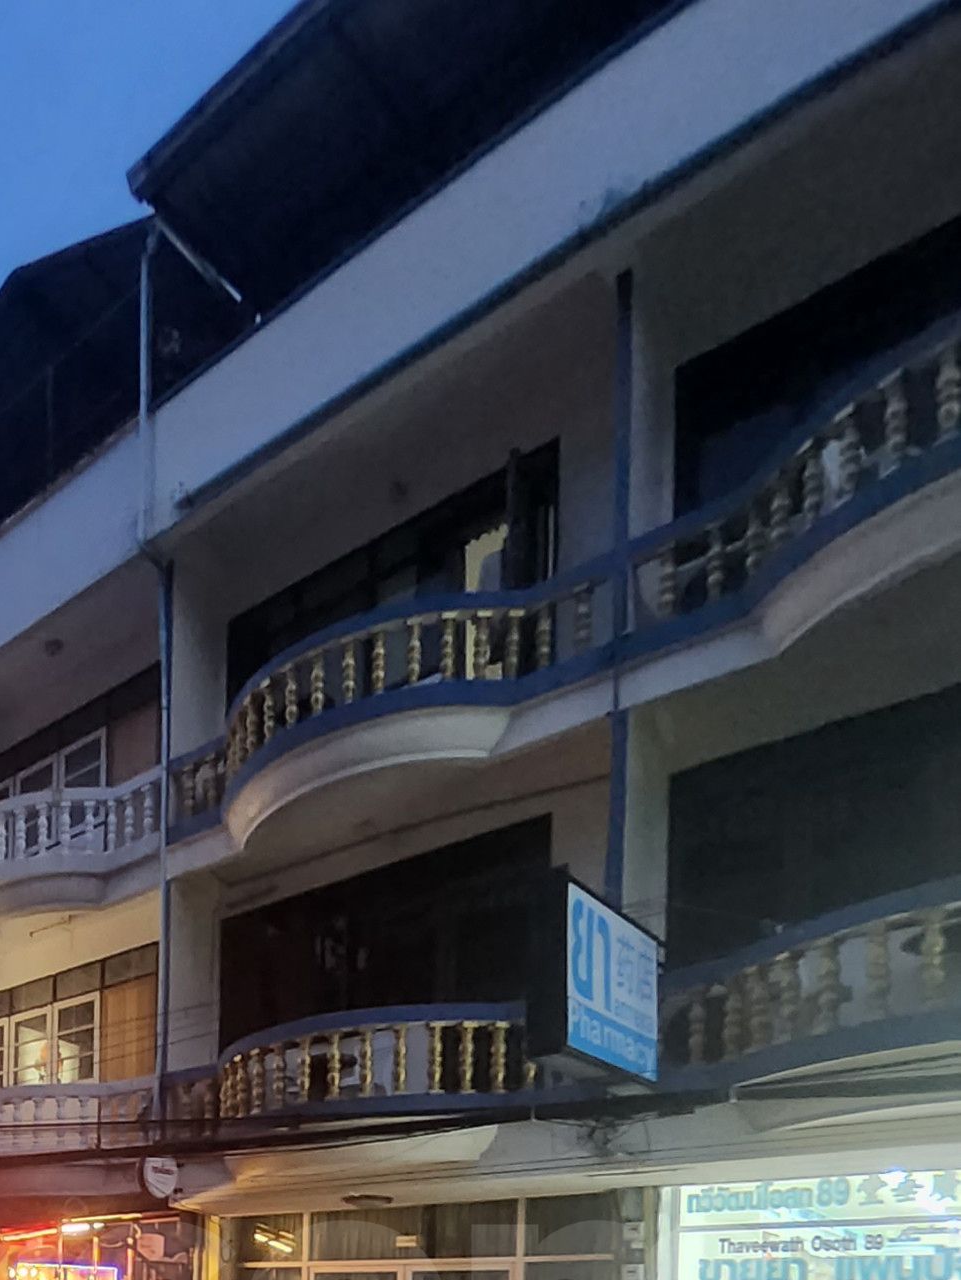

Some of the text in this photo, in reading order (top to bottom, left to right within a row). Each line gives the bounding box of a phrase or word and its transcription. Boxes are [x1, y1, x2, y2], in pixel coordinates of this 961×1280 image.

[571, 898, 613, 1012] ยา
[570, 999, 655, 1072] Pharmacy
[816, 1177, 850, 1207] 89
